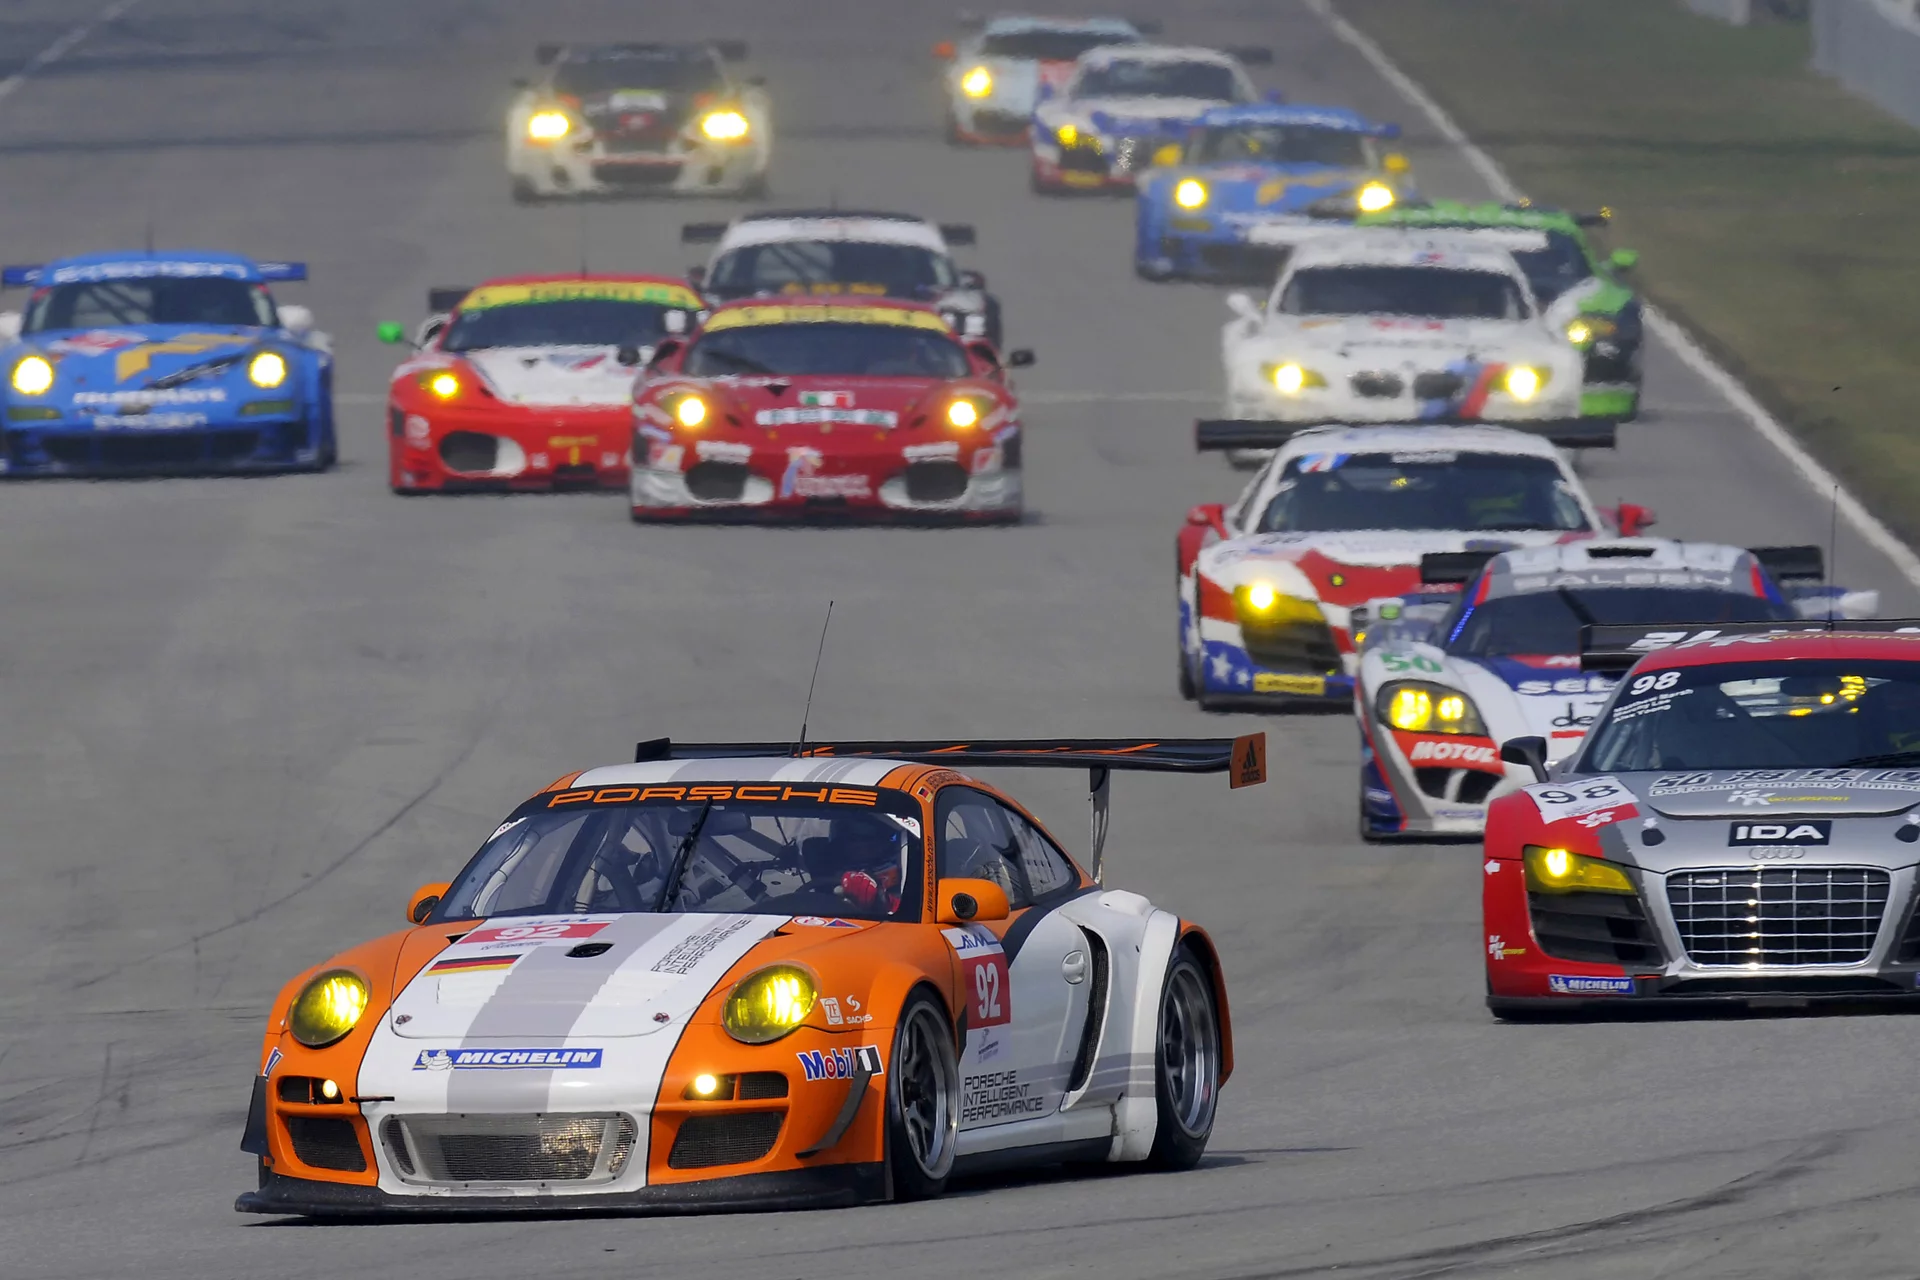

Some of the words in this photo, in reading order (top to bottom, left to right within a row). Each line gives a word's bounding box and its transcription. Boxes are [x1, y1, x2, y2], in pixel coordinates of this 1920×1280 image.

[1380, 653, 1443, 672] 50
[1630, 671, 1681, 695] 98
[1410, 741, 1496, 763] MOTUL
[1539, 785, 1619, 804] 98
[1738, 781, 1844, 790] Company
[548, 786, 878, 807] PORSCHE
[1736, 825, 1824, 840] IDA
[495, 925, 571, 941] 92
[650, 934, 702, 973] PORSCHE
[663, 927, 724, 974] INTELLIGENT
[676, 919, 752, 975] PERFORMANCE
[975, 962, 1000, 1019] 92
[1568, 979, 1630, 991] MICHELIN
[846, 1013, 873, 1024] SACHS
[456, 1051, 597, 1064] MICHELIN
[796, 1047, 855, 1081] Mobil
[964, 1070, 1017, 1091] PORSCHE
[963, 1083, 1030, 1107] INTELLIGENT
[962, 1096, 1044, 1123] PERFORMANCE
